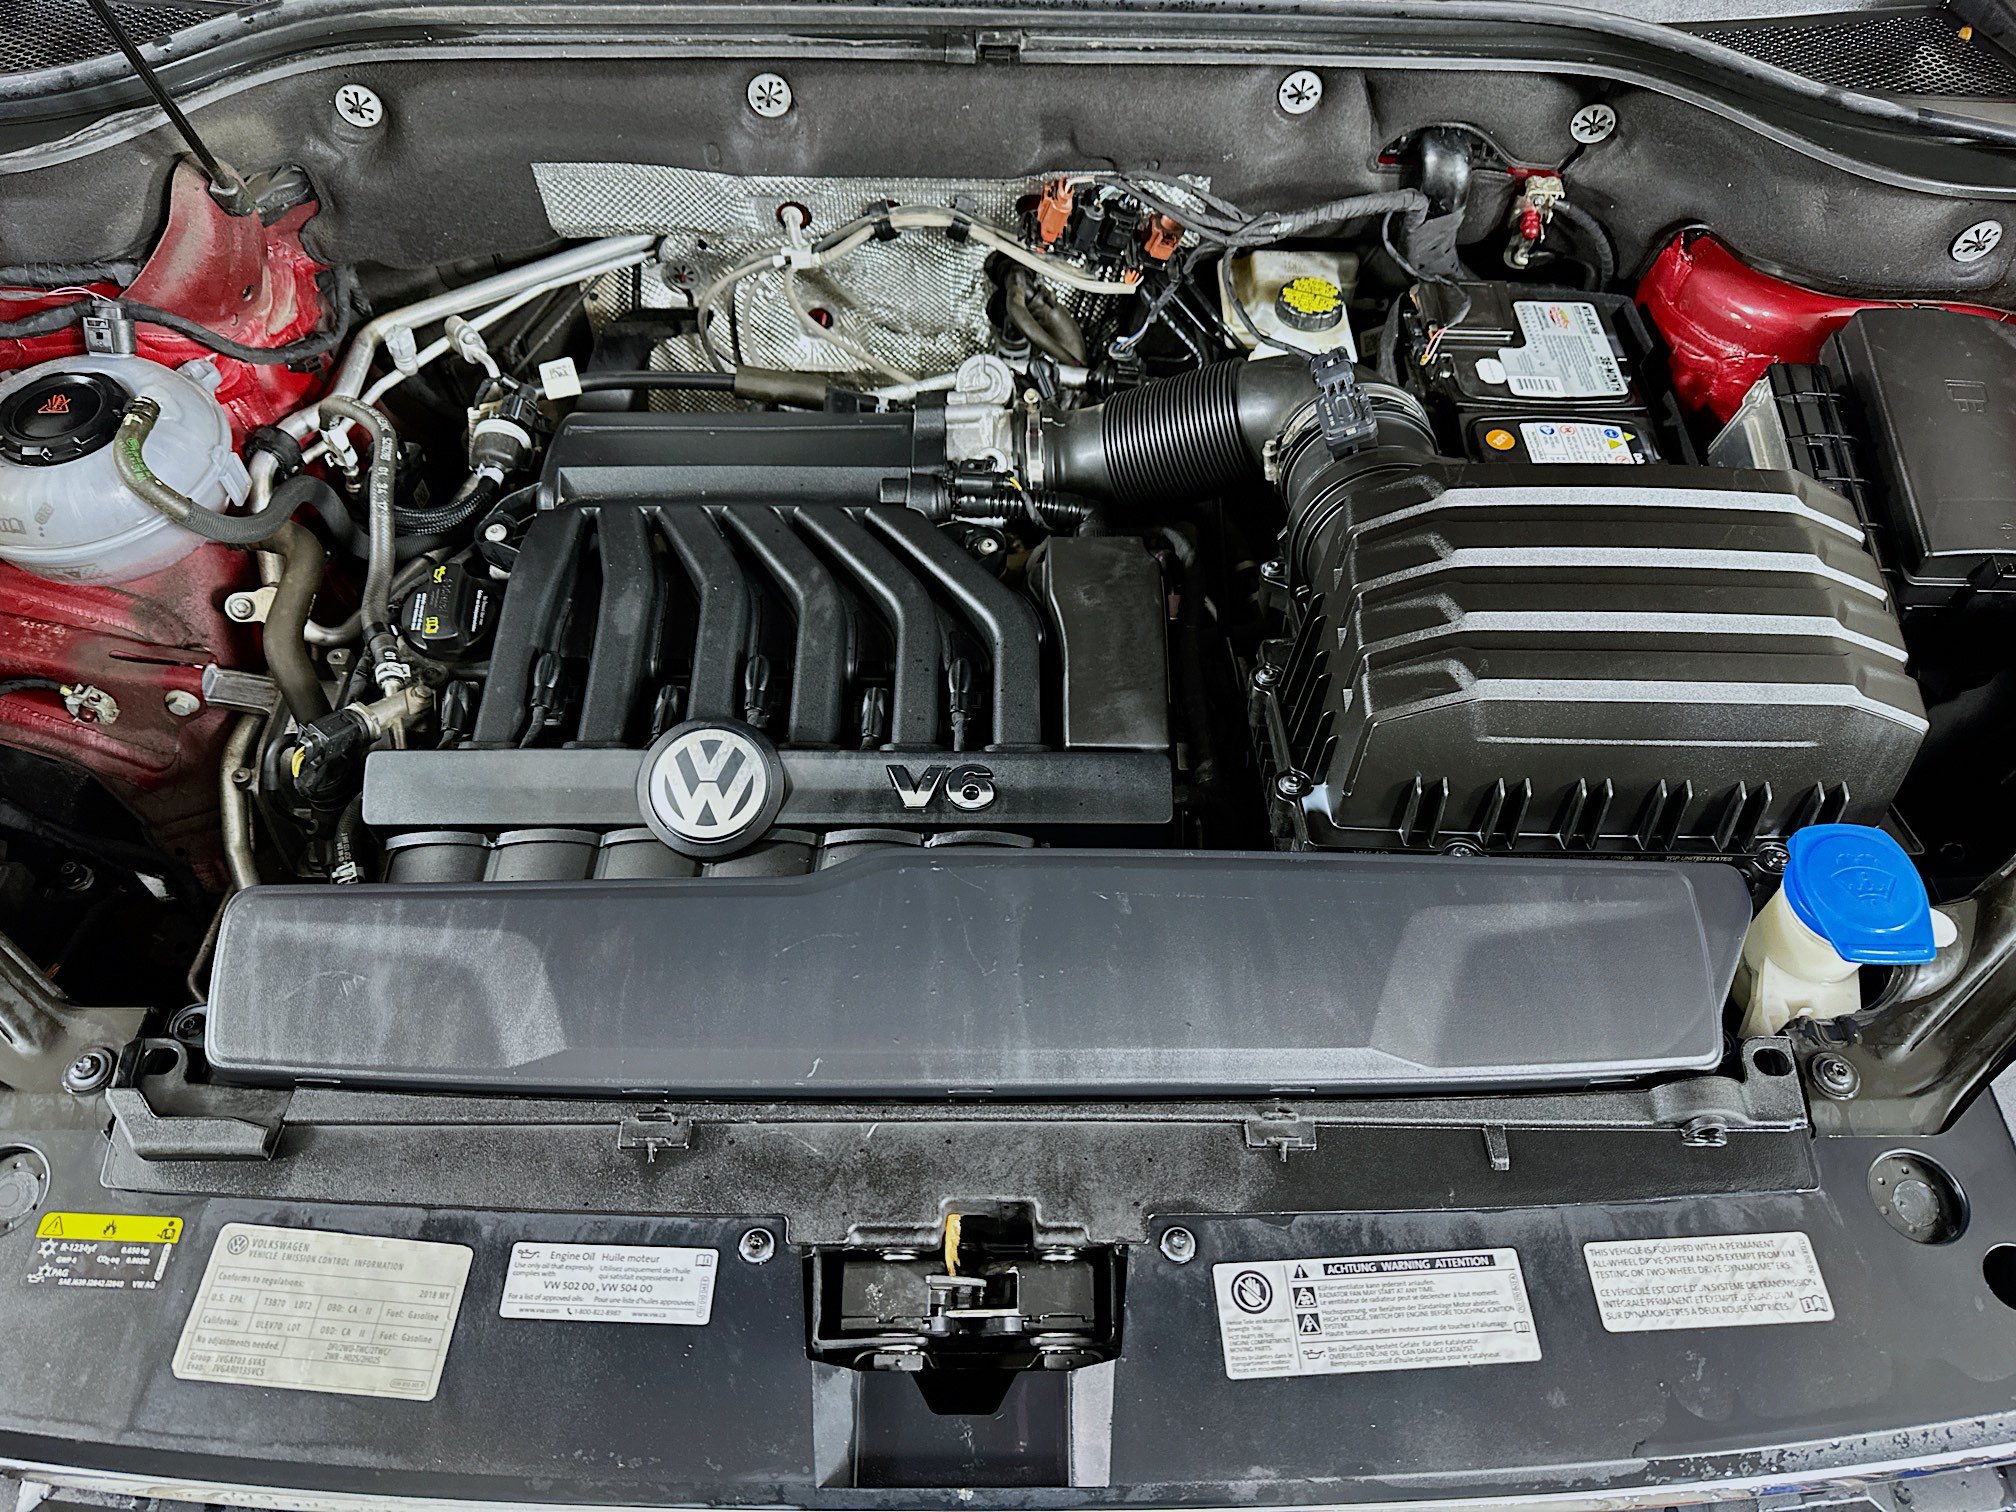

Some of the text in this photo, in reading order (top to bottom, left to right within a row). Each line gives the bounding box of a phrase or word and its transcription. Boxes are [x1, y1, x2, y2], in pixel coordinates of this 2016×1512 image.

[885, 763, 999, 811] V6
[252, 1238, 311, 1253] VOLKSWAGEN
[1589, 1248, 1609, 1257] THIS
[1609, 1246, 1644, 1256] VEHICLE
[1644, 1246, 1652, 1255] IS
[1694, 1243, 1718, 1252] WITH
[1719, 1242, 1725, 1251] A
[1725, 1240, 1774, 1250] PERMANENT
[249, 1250, 404, 1271] VEHICLE EMISSION CONTROL INFORMATION
[550, 1250, 661, 1264] Engine Oil Huile moteur
[1593, 1258, 1639, 1268] ALL-WHEEL
[1664, 1255, 1694, 1265] SYSTEM
[1696, 1254, 1715, 1263] AND
[1716, 1254, 1724, 1262] IS
[1725, 1252, 1756, 1262] EXEMPT
[1757, 1251, 1780, 1260] FROM
[527, 1262, 540, 1270] only
[565, 1264, 594, 1273] expressly
[624, 1266, 662, 1275] uniquement
[1327, 1256, 1490, 1275] ACHTUNG WARNING ATTENTION
[1595, 1269, 1630, 1279] TESTING
[1646, 1266, 1697, 1277] TWO-WHEEL
[1698, 1265, 1723, 1274] DRIVE
[51, 1268, 70, 1278] PAG
[218, 1271, 305, 1289] Conforms to regulations:
[541, 1270, 556, 1278] with
[598, 1273, 608, 1281] qui
[610, 1273, 634, 1281] satisfait
[544, 1280, 561, 1290] VW
[562, 1281, 580, 1291] 502
[602, 1283, 619, 1292] VW
[620, 1283, 637, 1293] 504
[640, 1284, 653, 1294] 00
[419, 1289, 450, 1300] 2018 MY
[542, 1294, 571, 1303] approved
[1319, 1291, 1348, 1299] RADIATOR
[348, 1304, 358, 1314] CA
[386, 1308, 405, 1318] Fuel:
[408, 1310, 439, 1322] Gasoline
[1431, 1309, 1452, 1317] BEFORE
[1454, 1307, 1486, 1315] TOUCHING
[1488, 1305, 1515, 1313] IGNITION
[203, 1315, 240, 1327] California:
[341, 1327, 351, 1337] CA
[380, 1331, 398, 1341] Fuel:
[401, 1332, 433, 1344] Gasoline
[195, 1335, 280, 1350] No adjustments needed.
[1376, 1342, 1398, 1350] besteht
[1329, 1352, 1365, 1360] OVERFILLED
[1365, 1350, 1389, 1358] ENGINE
[1417, 1347, 1443, 1355] DAMAGE
